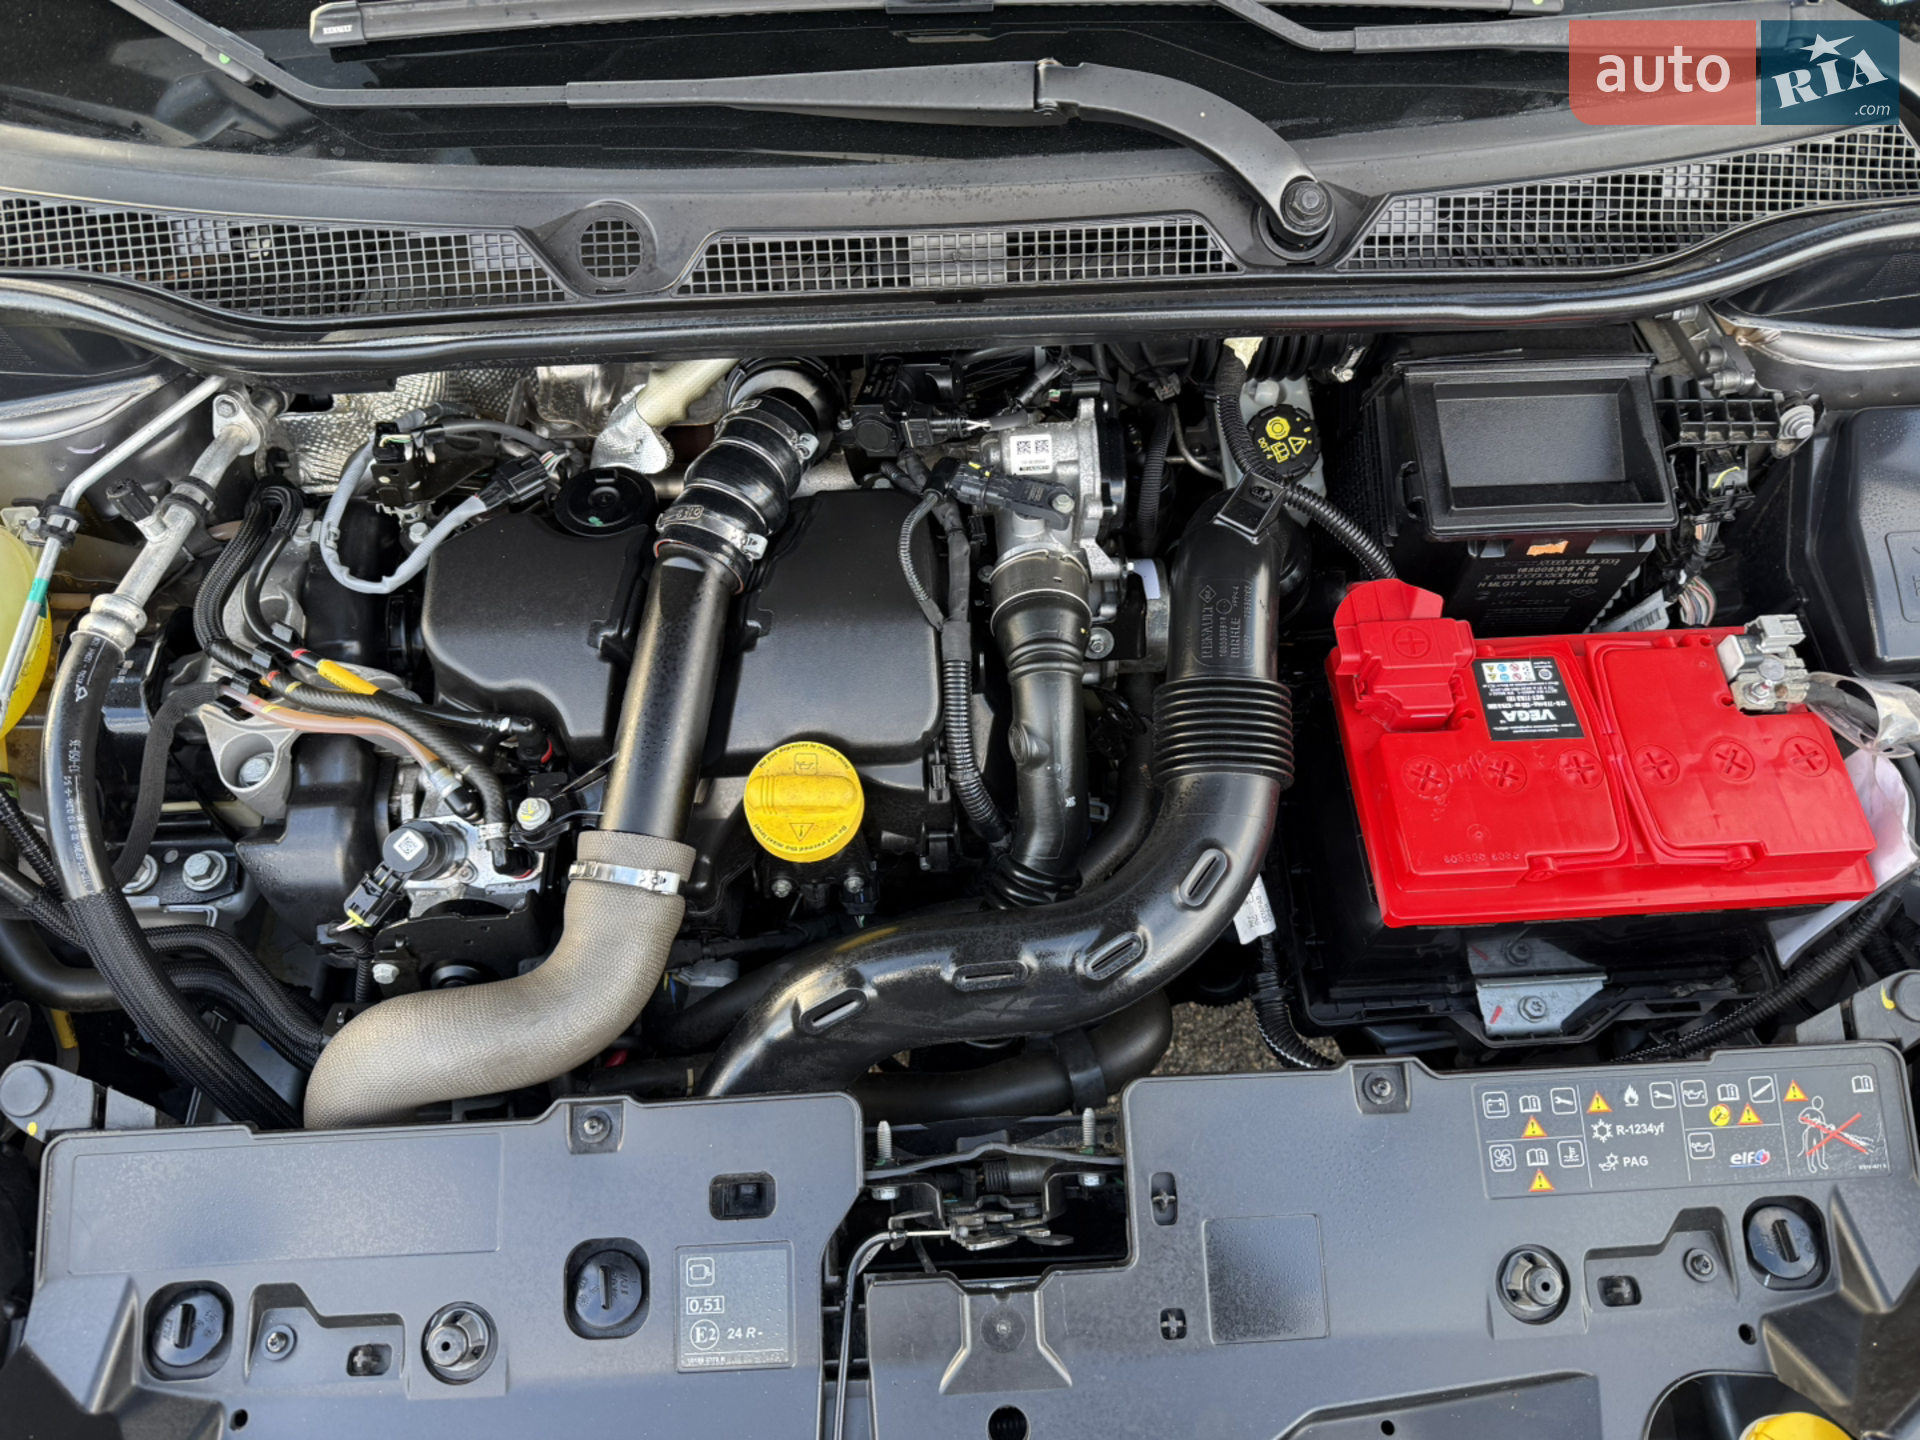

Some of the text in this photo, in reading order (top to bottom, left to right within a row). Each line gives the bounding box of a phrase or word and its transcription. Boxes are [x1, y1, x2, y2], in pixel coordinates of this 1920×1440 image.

[1257, 436, 1272, 453] DOT
[1200, 604, 1214, 659] RENAULT
[1229, 616, 1241, 659] MAHLE
[1500, 709, 1557, 722] VEGA
[1615, 1122, 1665, 1137] R-1234yf
[1622, 1155, 1649, 1168] PAG
[1730, 1151, 1755, 1165] elf
[688, 1297, 722, 1314] 0,51
[727, 1327, 743, 1340] 24
